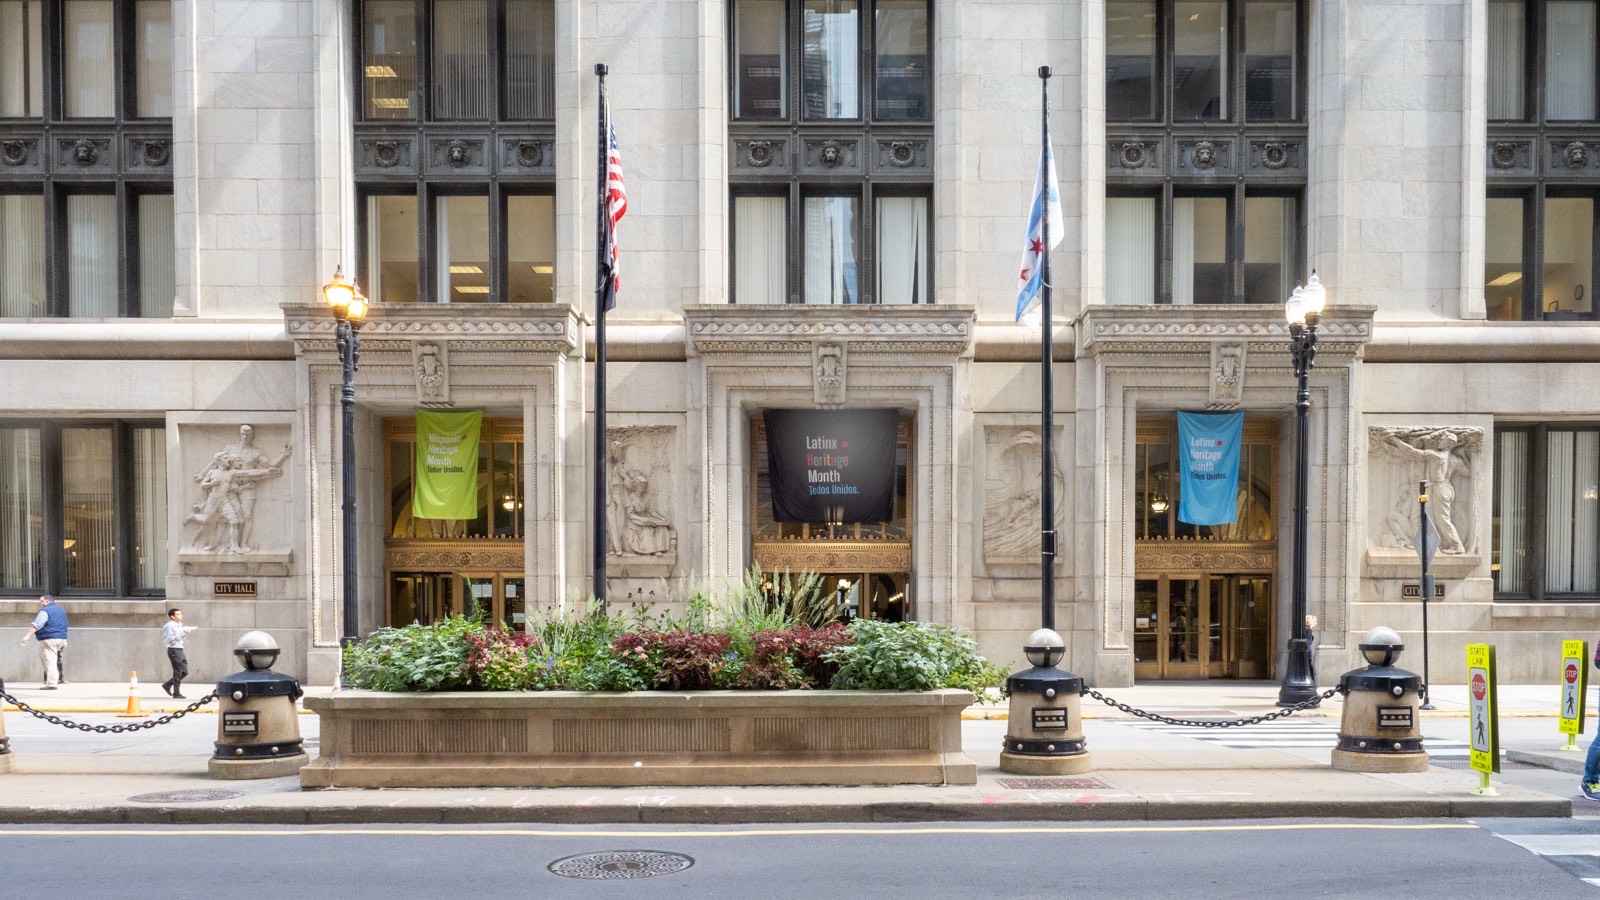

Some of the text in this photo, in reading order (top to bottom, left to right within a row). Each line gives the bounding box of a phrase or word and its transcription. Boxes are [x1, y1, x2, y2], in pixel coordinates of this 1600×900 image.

[429, 433, 461, 445] Hispanic
[806, 436, 837, 450] Latinx
[1191, 436, 1215, 448] Latino
[428, 444, 459, 455] Heritage
[1190, 448, 1222, 462] Heritage
[427, 455, 452, 465] Month
[806, 452, 849, 469] Heritage
[1191, 461, 1214, 472] Month
[808, 469, 841, 483] Month
[809, 484, 860, 496] Todos Unidos.
[215, 584, 255, 593] CITY HALL
[1404, 586, 1420, 595] CITY
[1470, 647, 1485, 656] STATE
[1565, 670, 1577, 678] STOP
[1472, 681, 1485, 692] STOP
